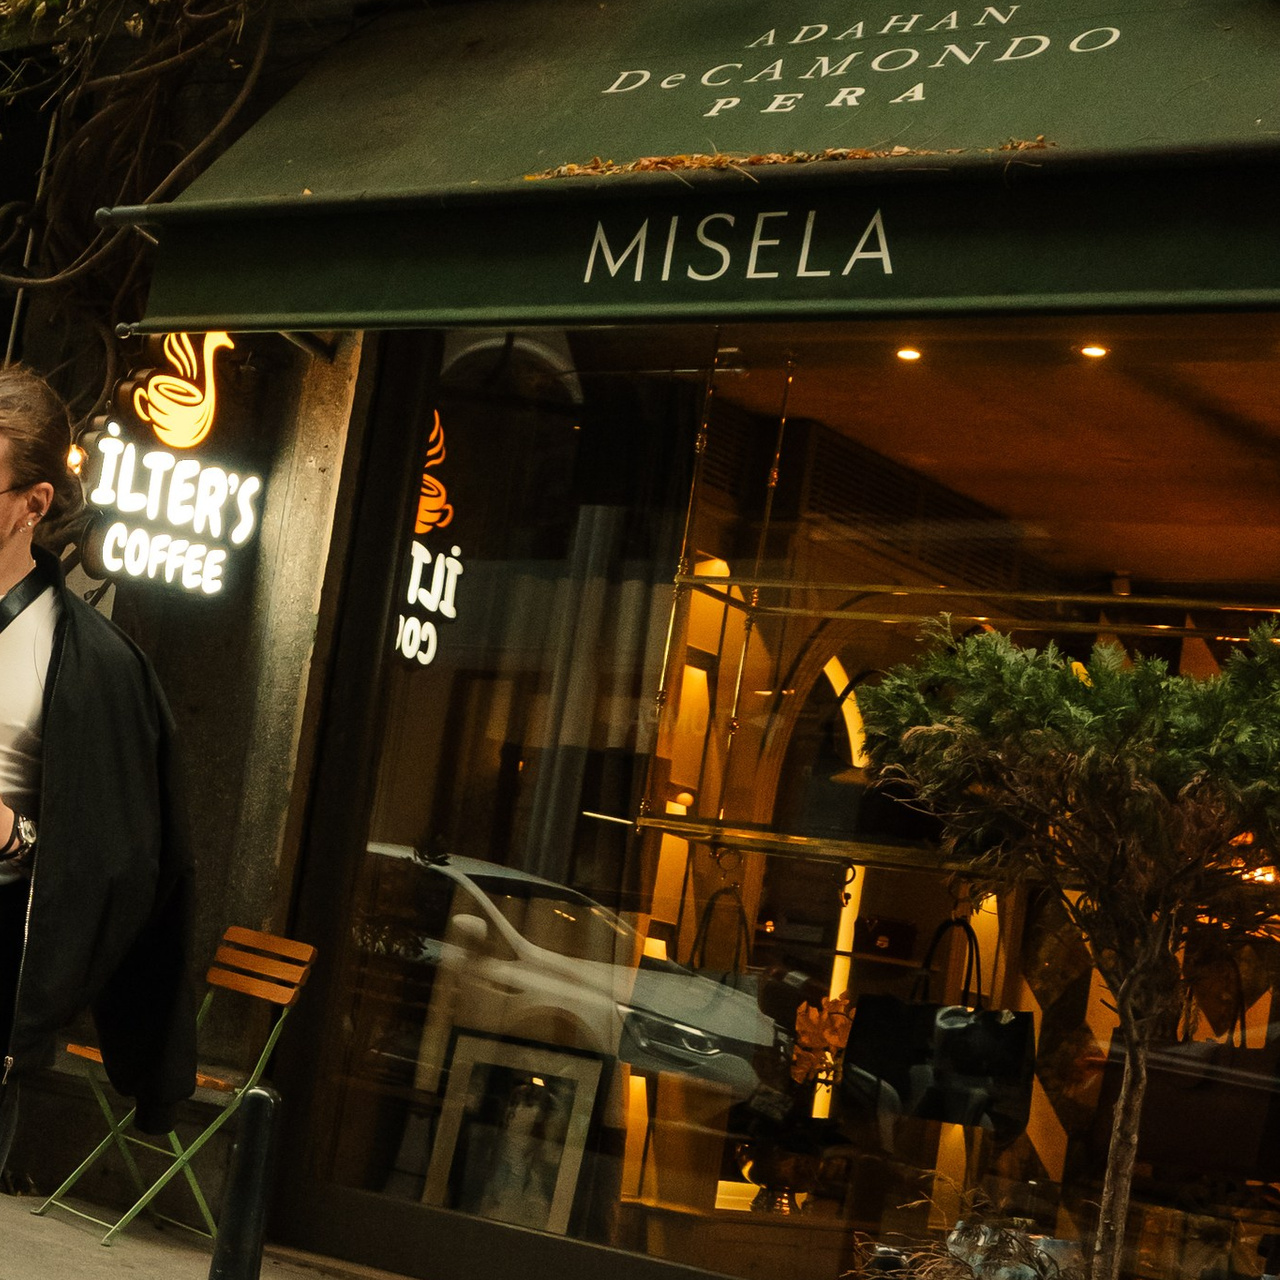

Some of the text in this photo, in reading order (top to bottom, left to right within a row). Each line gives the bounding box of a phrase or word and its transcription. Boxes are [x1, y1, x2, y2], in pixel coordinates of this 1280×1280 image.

[601, 26, 1122, 95] DeCAMONDO
[744, 5, 1022, 50] ADAHAN
[703, 82, 926, 118] PERA
[583, 208, 895, 284] MISELA
[90, 421, 261, 546] İLTER'S
[102, 521, 229, 596] COFFEE
